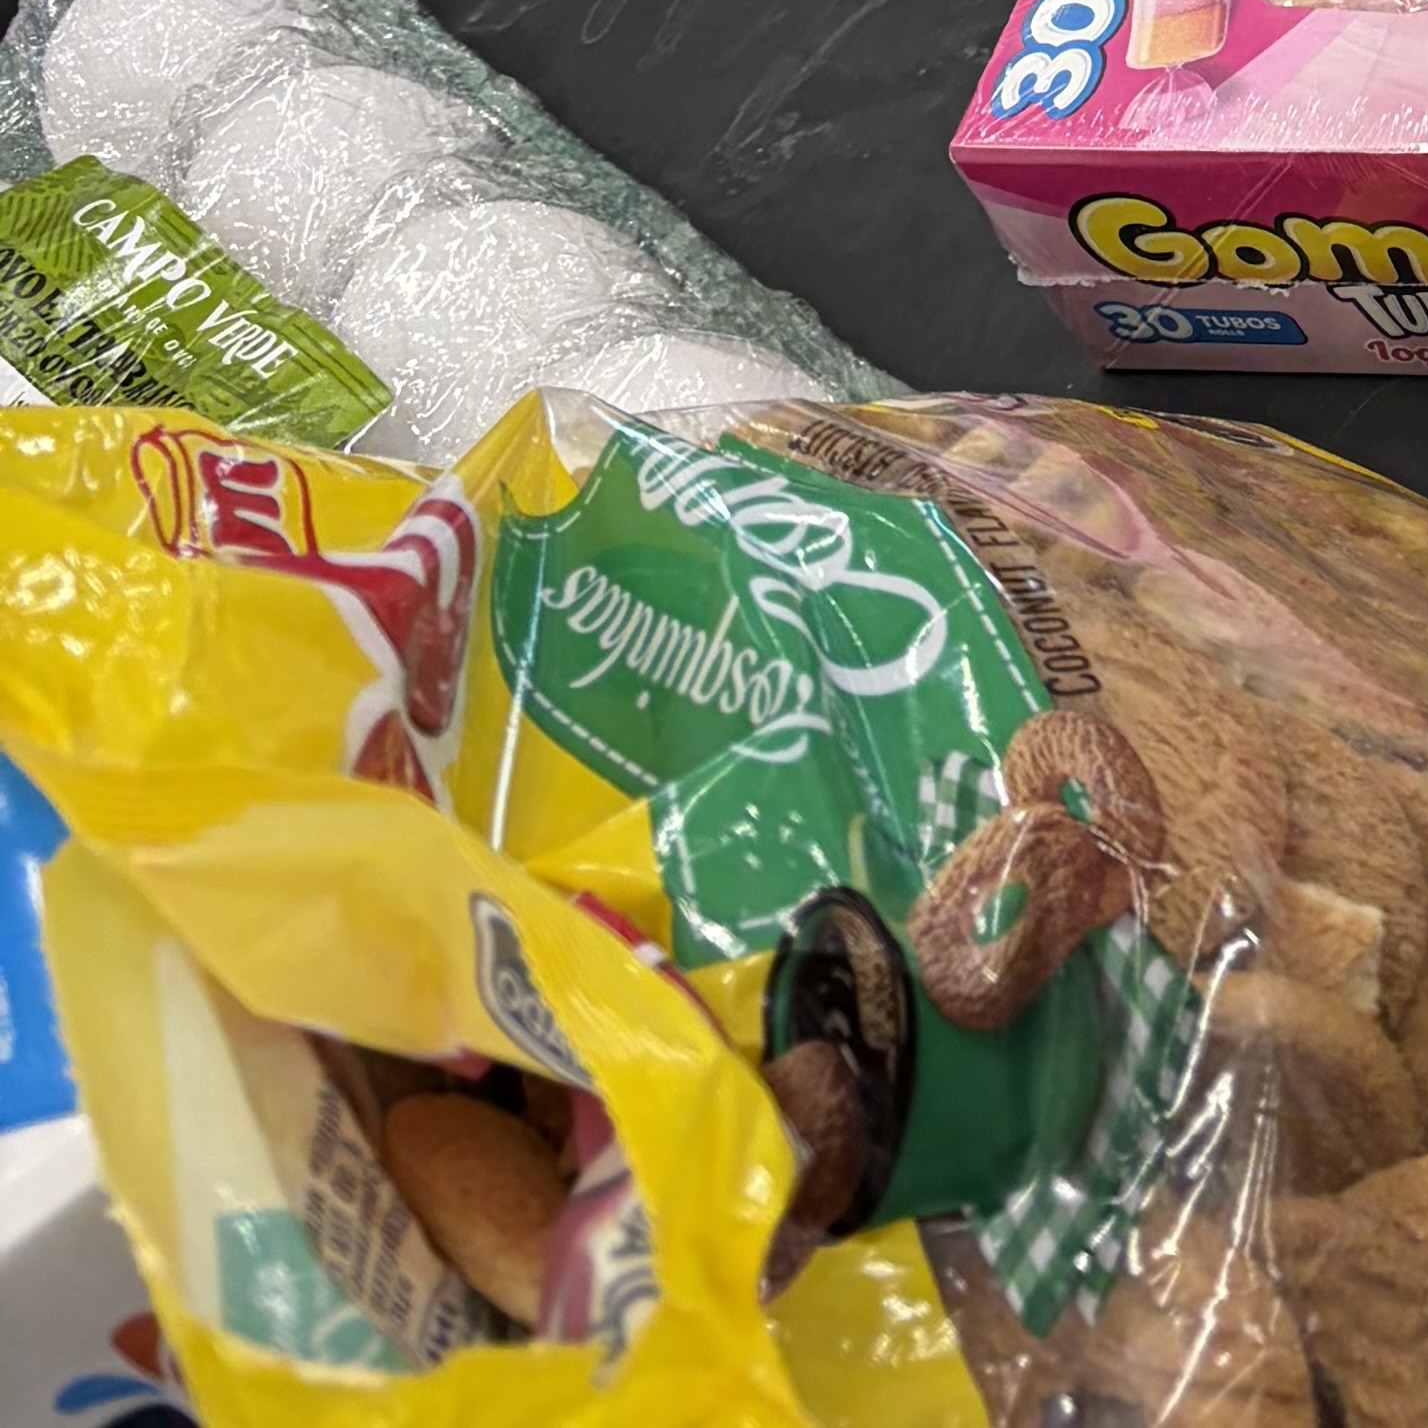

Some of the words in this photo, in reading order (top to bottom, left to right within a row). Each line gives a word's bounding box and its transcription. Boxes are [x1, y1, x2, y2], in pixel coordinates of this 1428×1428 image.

[73, 199, 212, 312] CAMPO
[196, 298, 299, 381] VERDE
[1096, 298, 1195, 345] 30
[1194, 312, 1283, 334] TUBOS
[799, 418, 907, 482] BISCUIT
[1004, 559, 1101, 699] COCONUT
